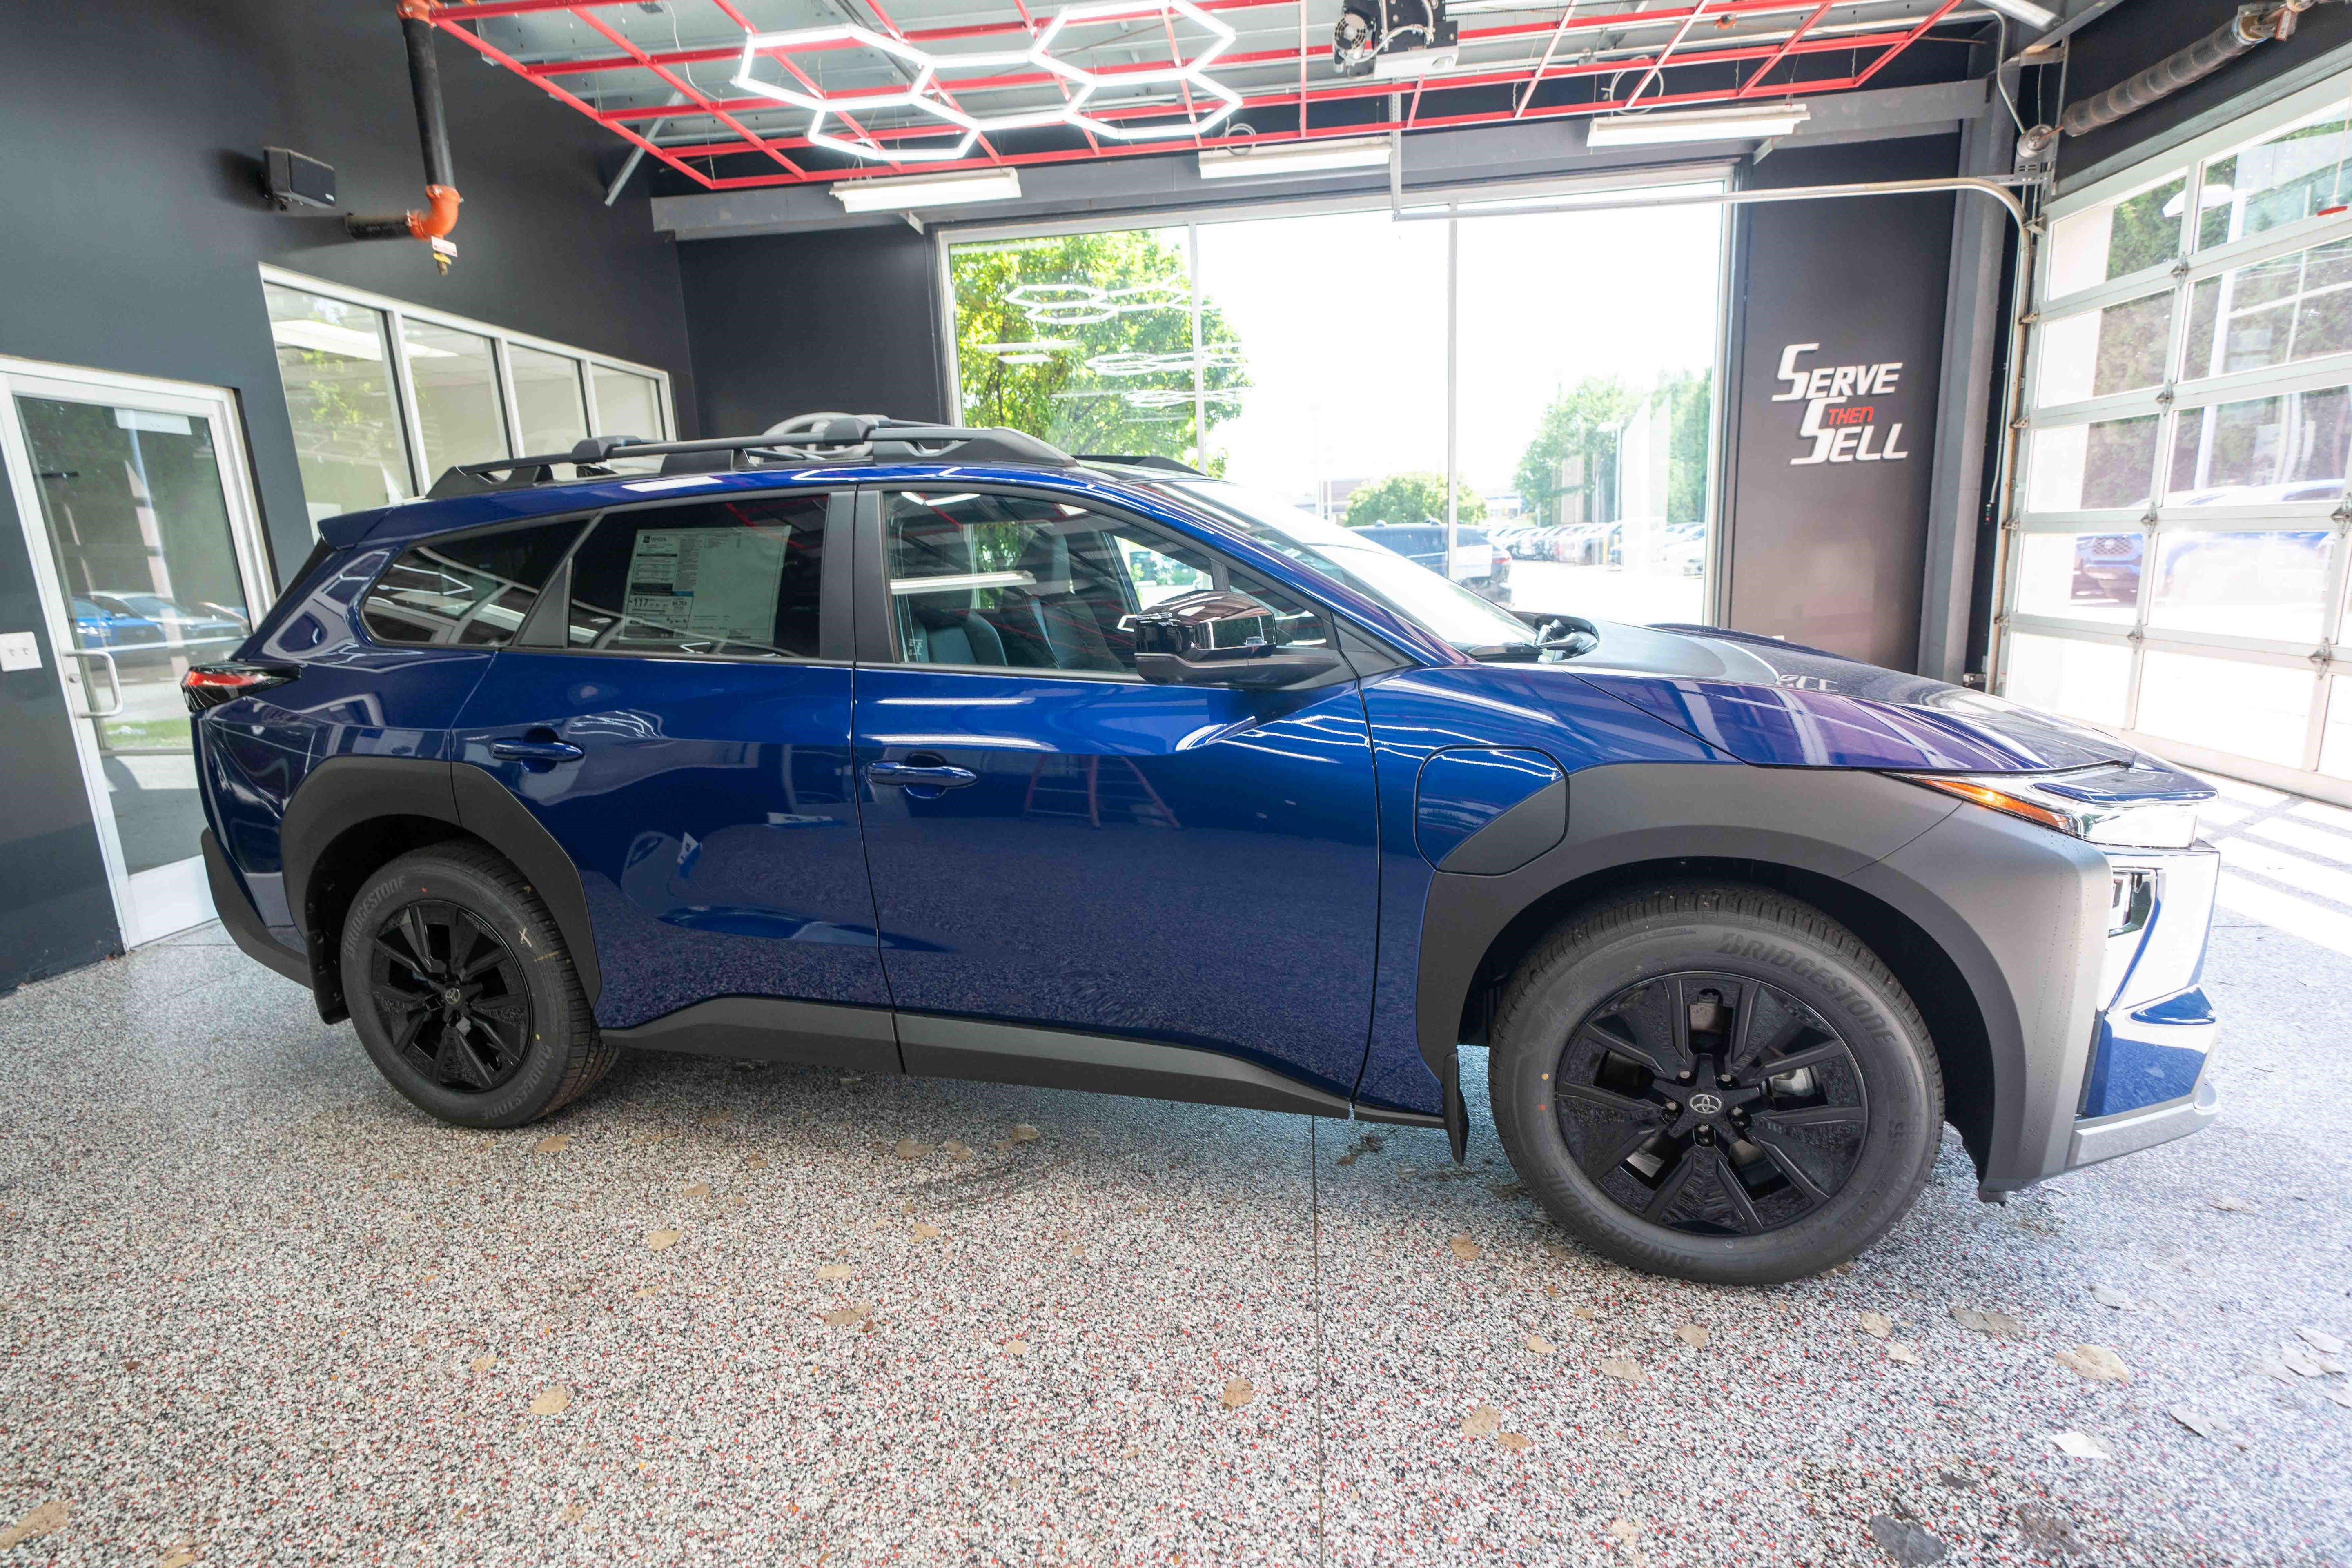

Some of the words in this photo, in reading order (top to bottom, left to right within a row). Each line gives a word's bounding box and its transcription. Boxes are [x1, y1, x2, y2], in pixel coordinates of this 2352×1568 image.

[1771, 343, 1903, 401] SERVE
[1790, 396, 1909, 465] SELL
[1828, 406, 1874, 425] THEN
[344, 876, 405, 961] BRIDGESTONE
[1716, 933, 1899, 1045] BRIDGESTONE
